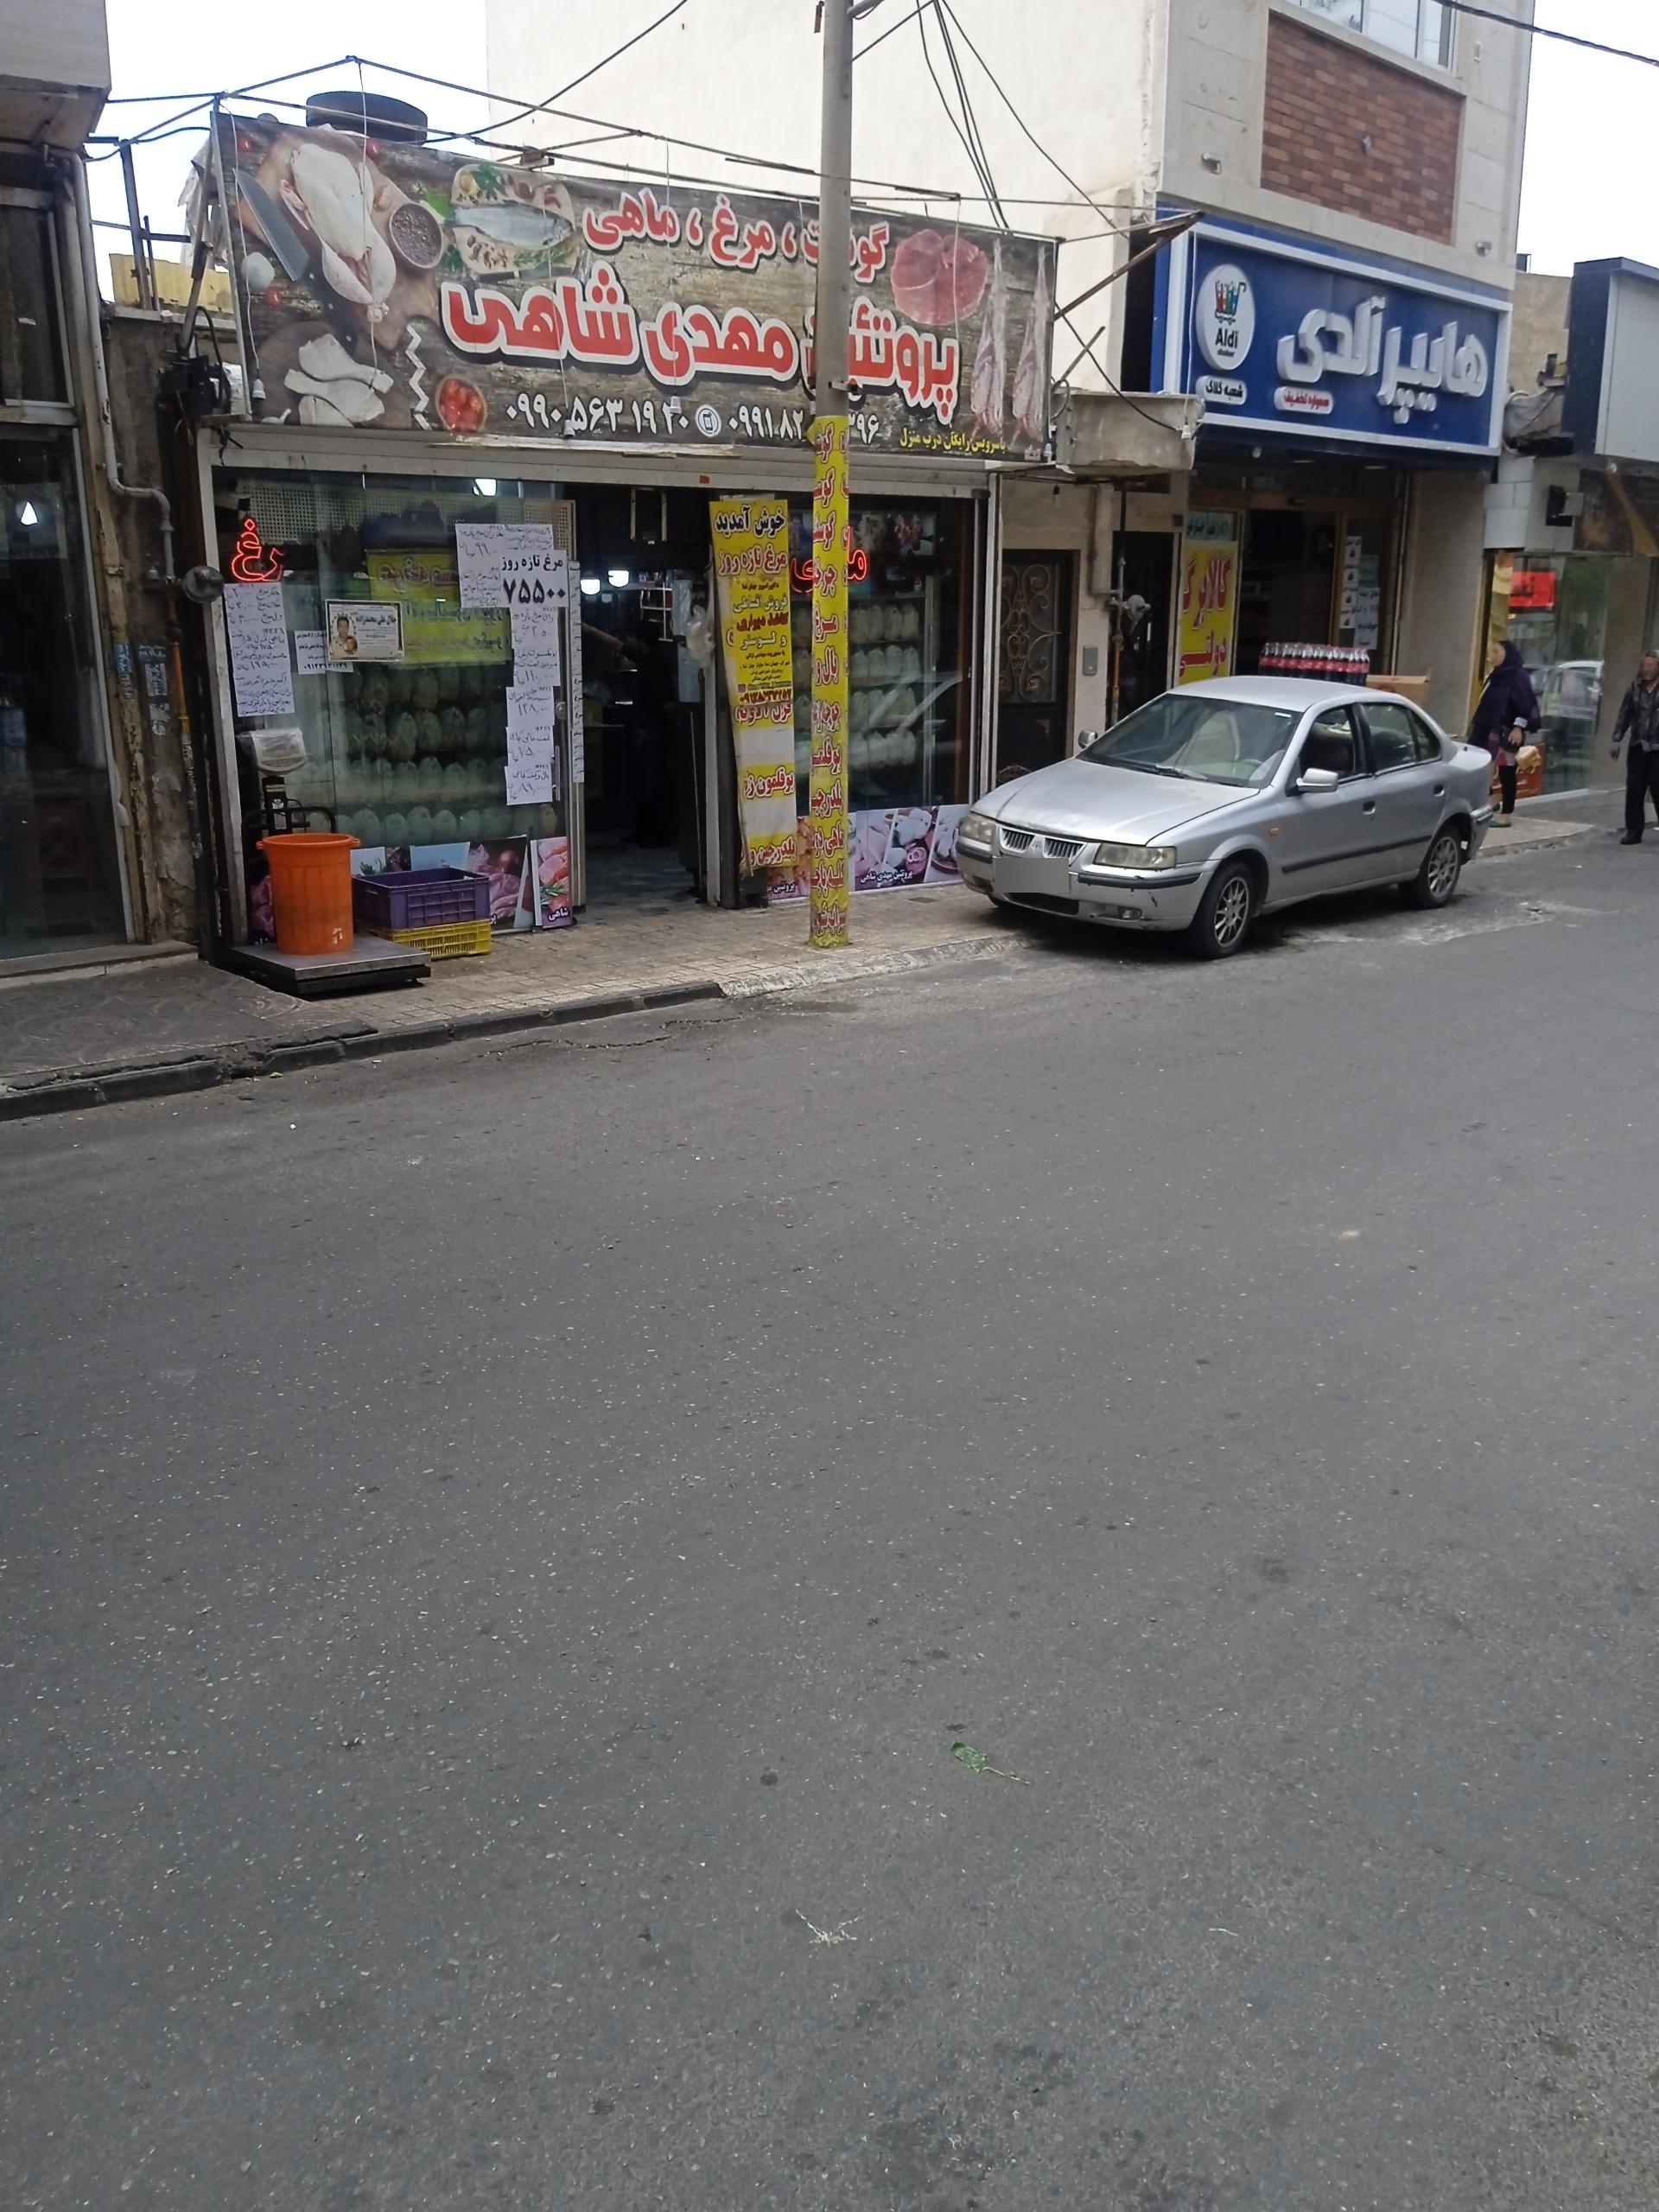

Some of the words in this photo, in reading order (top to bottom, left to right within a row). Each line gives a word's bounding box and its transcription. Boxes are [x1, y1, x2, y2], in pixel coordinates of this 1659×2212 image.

[582, 187, 679, 250] ماهی
[708, 194, 776, 270] مرغ
[801, 221, 889, 283] گوت
[440, 261, 639, 365] شاهی
[639, 301, 799, 385] مهدی
[1215, 327, 1238, 349] Aldi
[800, 296, 959, 424] پروتئ
[1377, 321, 1487, 425] هایپر
[1224, 384, 1243, 401] شعبه
[899, 427, 921, 448] منزل
[923, 434, 942, 449] درب
[715, 505, 750, 537] آمدید
[754, 508, 787, 537] خوش
[501, 556, 518, 571] روز
[522, 554, 541, 570] تازه
[543, 554, 563, 571] مرغ
[718, 549, 741, 576] روز
[741, 544, 762, 574] تازه
[763, 543, 788, 575] مرغ
[791, 526, 868, 593] مای
[503, 578, 567, 604] ۷۵۵۰۰
[764, 593, 788, 612] فروش
[780, 635, 786, 647] و
[756, 766, 795, 798] بوقلمون
[758, 836, 796, 867] بلدرچین
[824, 820, 844, 858] ماهی
[860, 873, 876, 885] شاهی
[877, 871, 893, 888] مهدی
[548, 906, 569, 922] شاهی
